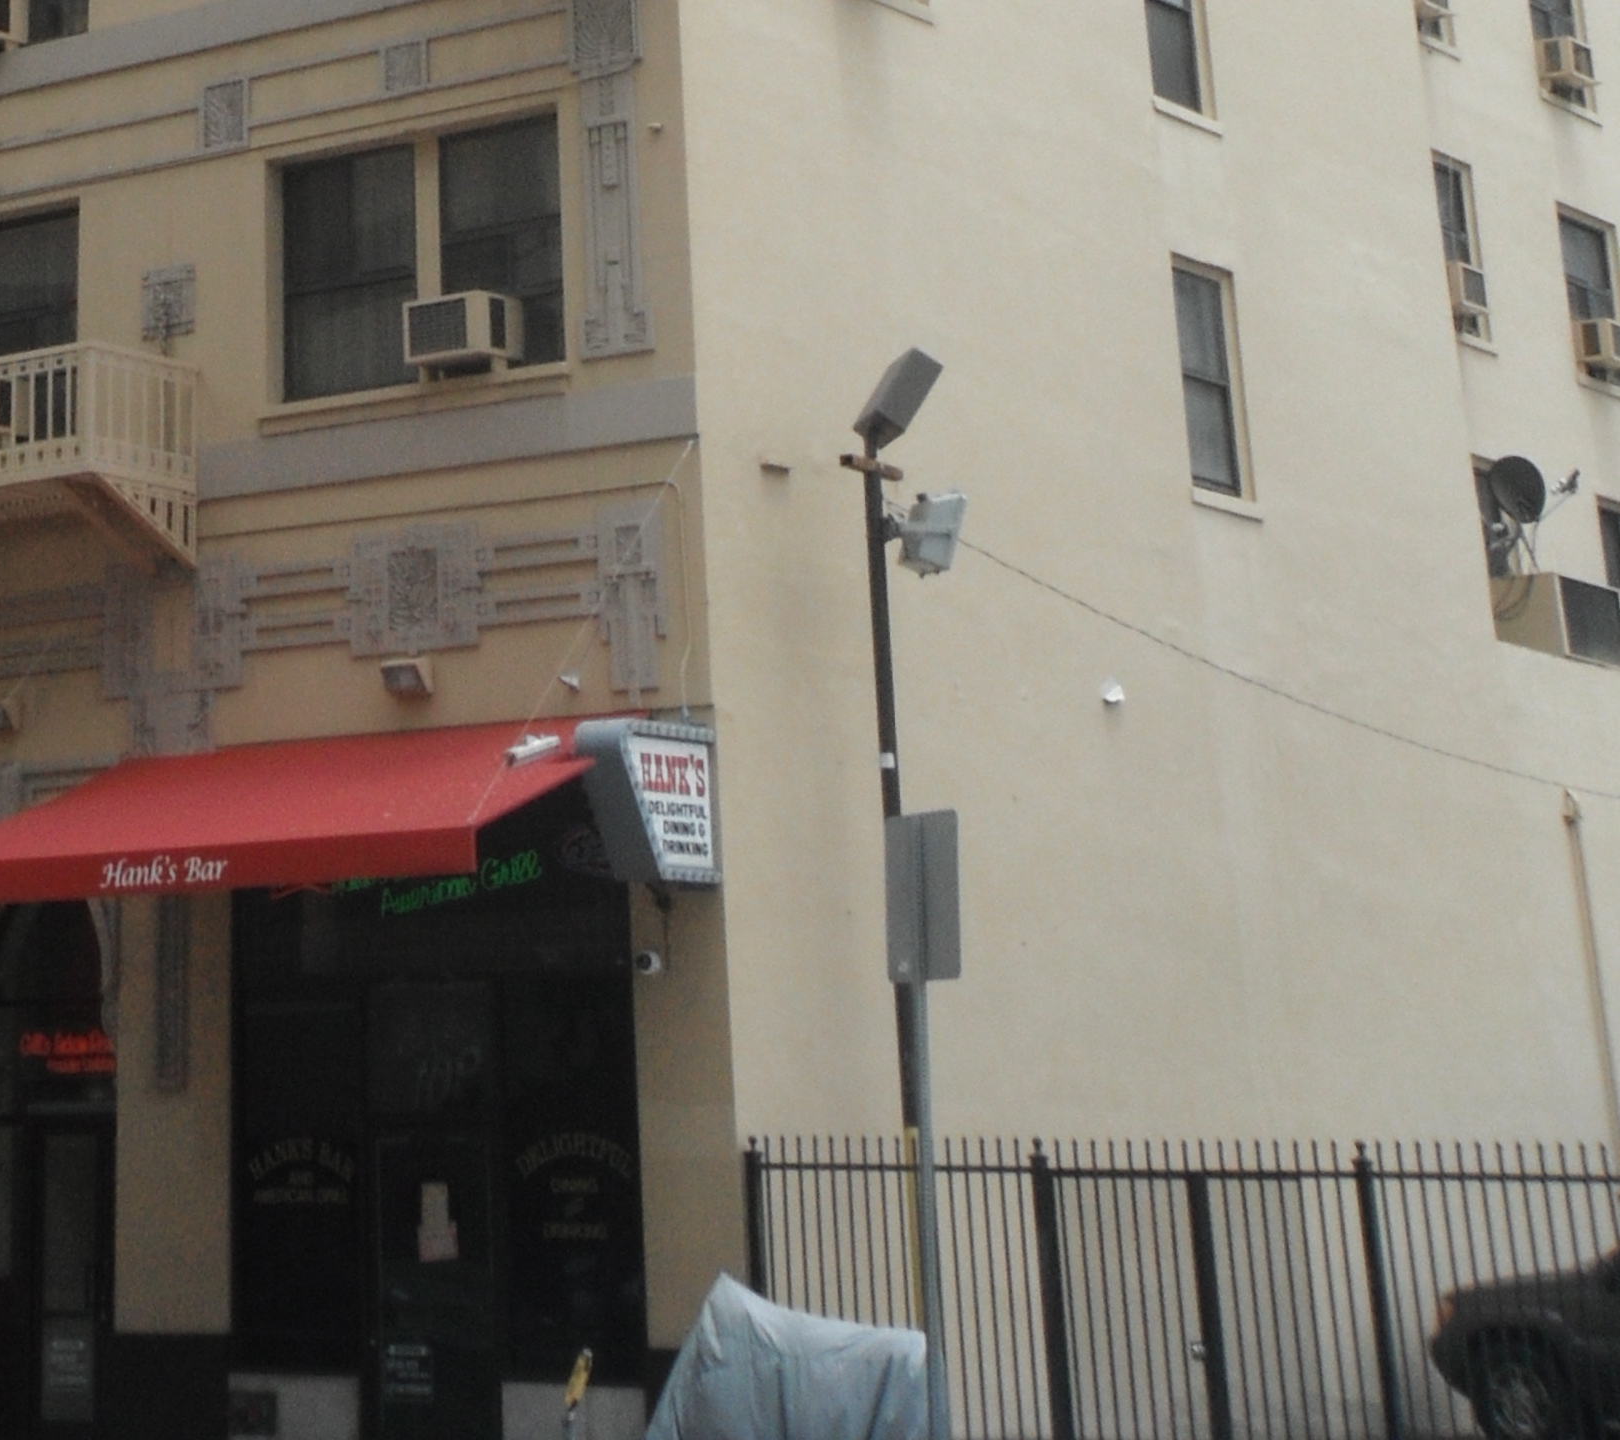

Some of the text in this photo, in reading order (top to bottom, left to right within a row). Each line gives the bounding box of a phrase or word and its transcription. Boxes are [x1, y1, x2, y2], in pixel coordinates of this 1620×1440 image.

[640, 752, 706, 797] HANK'S
[648, 800, 708, 820] DELIGHTFUL
[663, 820, 697, 836] DINING
[662, 839, 709, 858] DRINKING
[99, 854, 228, 889] Hank's Bar
